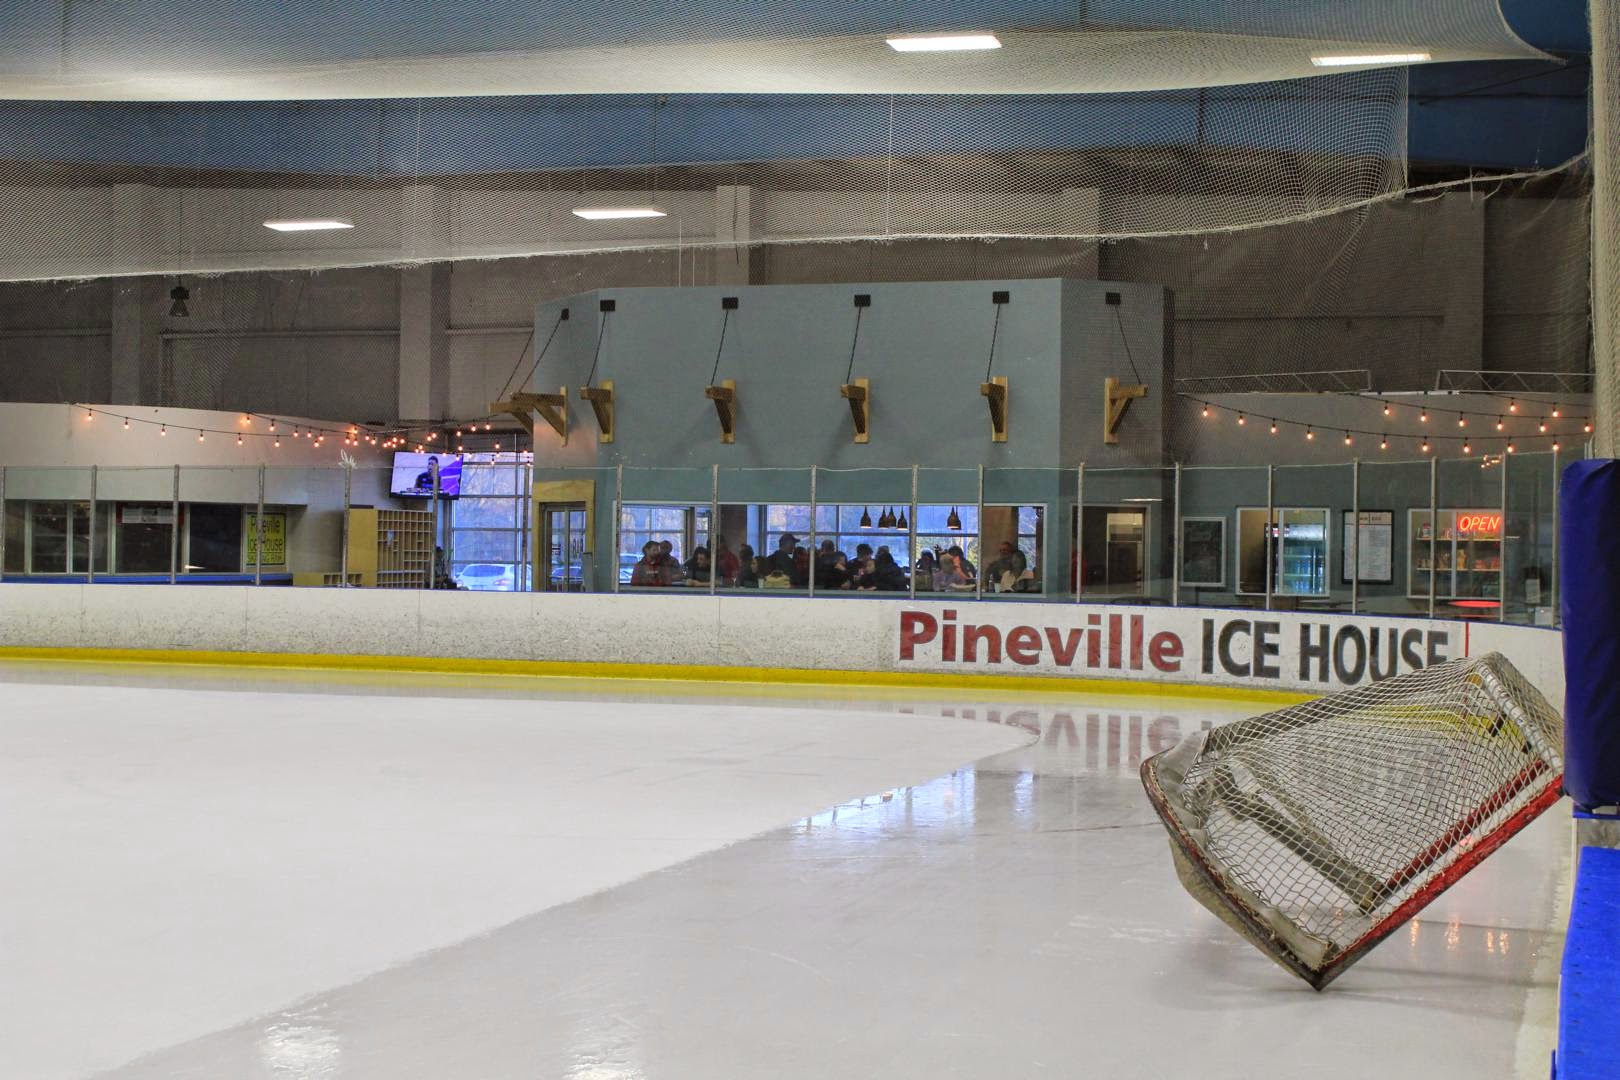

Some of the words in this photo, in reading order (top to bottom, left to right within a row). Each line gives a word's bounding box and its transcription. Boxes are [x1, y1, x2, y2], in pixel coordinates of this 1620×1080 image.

[250, 515, 280, 533] Pieville
[1459, 515, 1501, 532] OPEN
[899, 609, 1184, 673] Pineville
[1201, 618, 1281, 679] ICE
[1299, 622, 1448, 685] HOUSE
